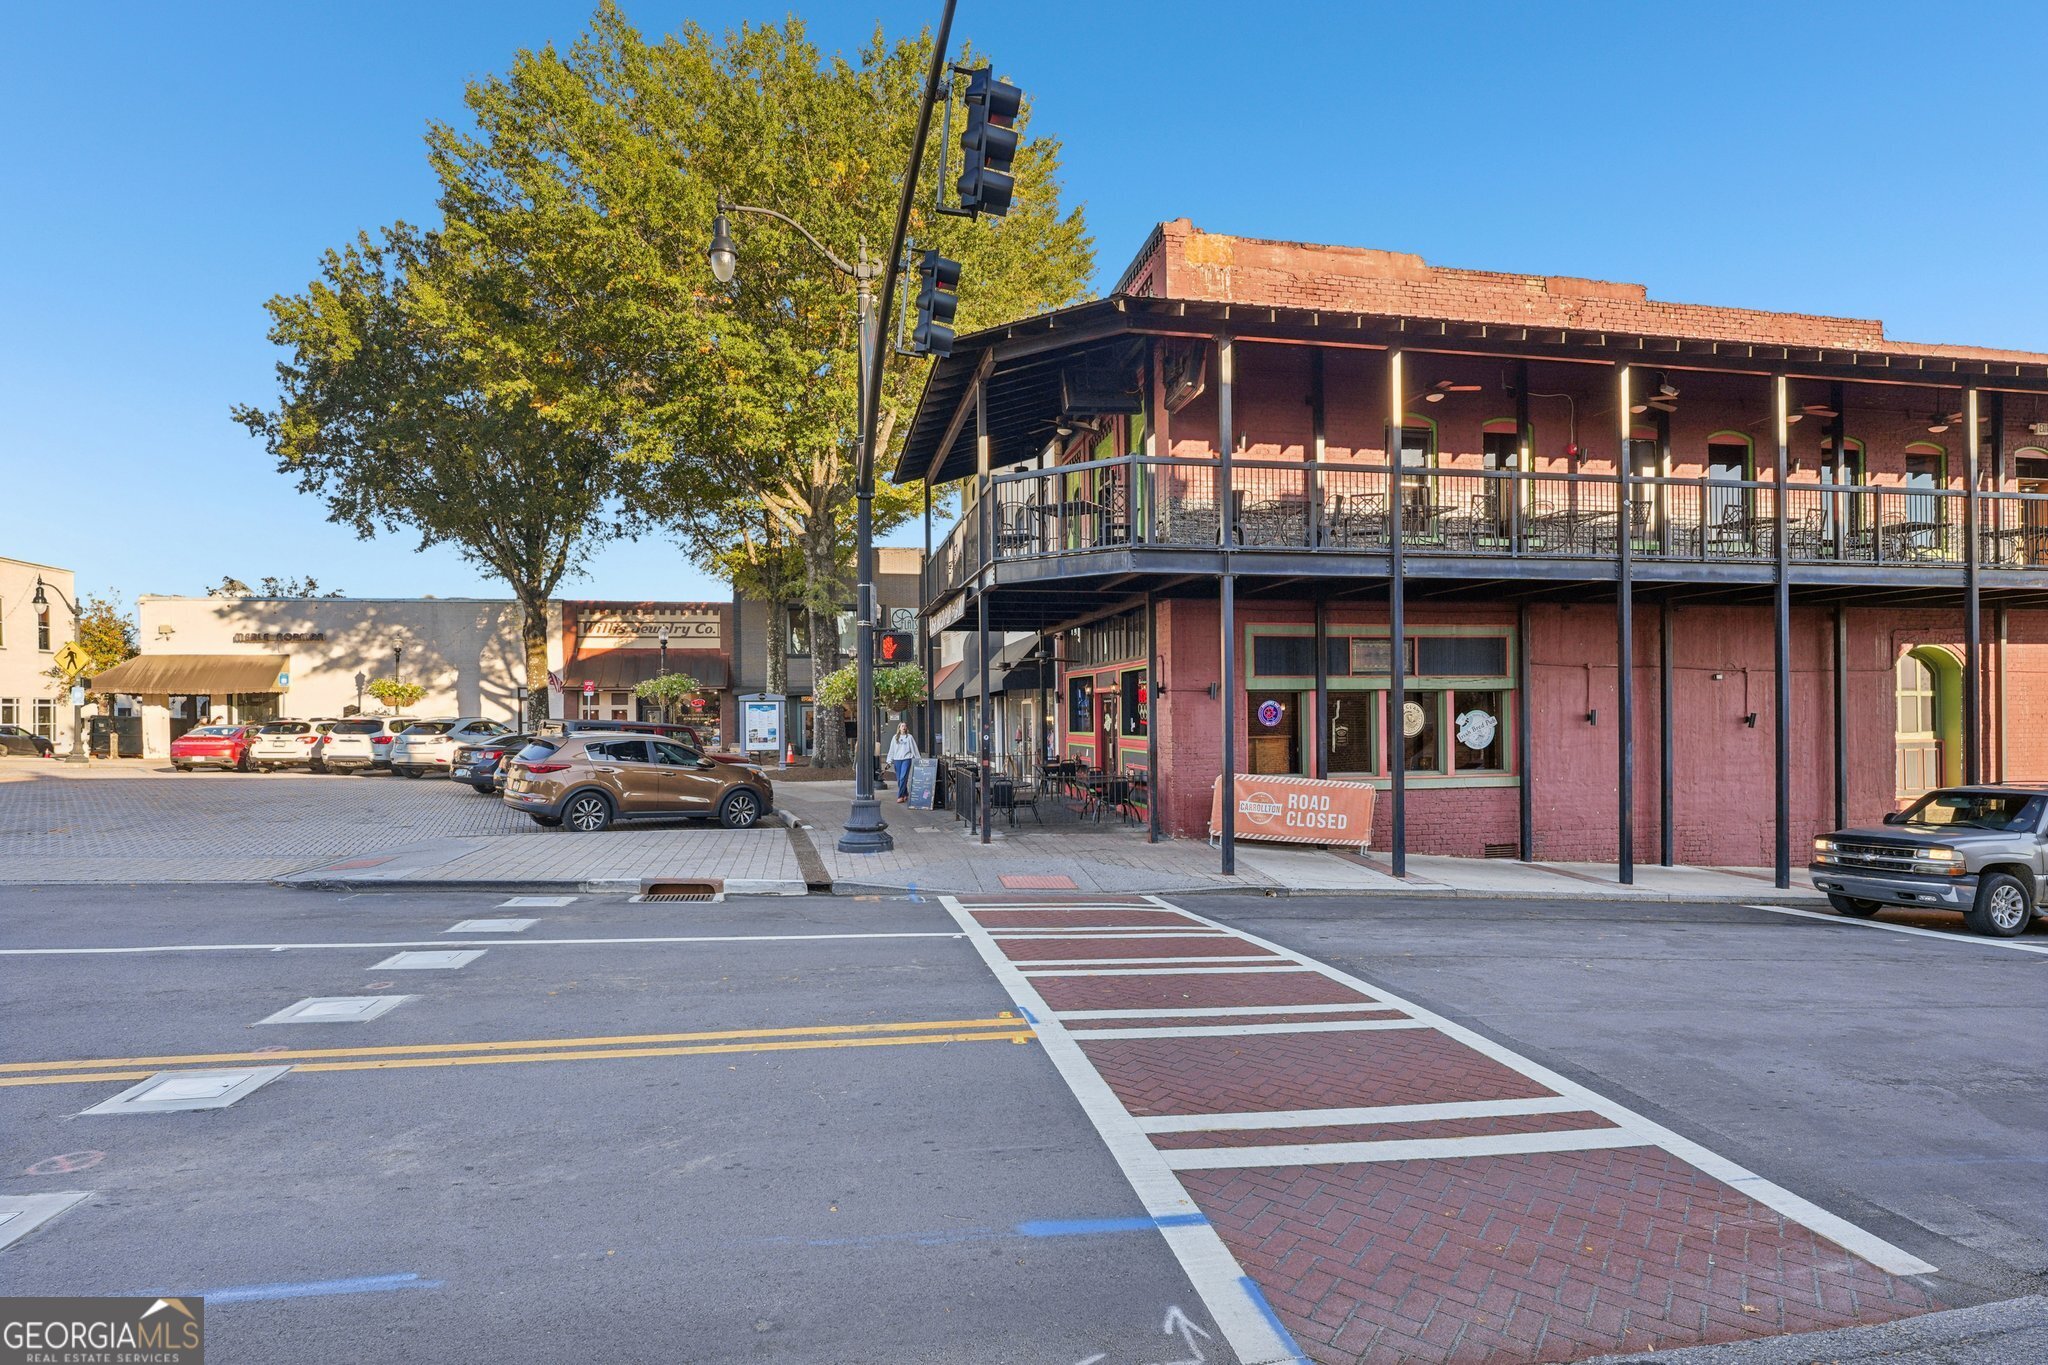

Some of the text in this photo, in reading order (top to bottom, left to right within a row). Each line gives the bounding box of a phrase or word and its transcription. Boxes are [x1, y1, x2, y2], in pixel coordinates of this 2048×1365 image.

[583, 622, 716, 637] Willis Jewlry Co.
[1240, 802, 1281, 814] CARROLLTON
[1288, 793, 1330, 811] ROAD
[1286, 811, 1348, 830] CLOSED
